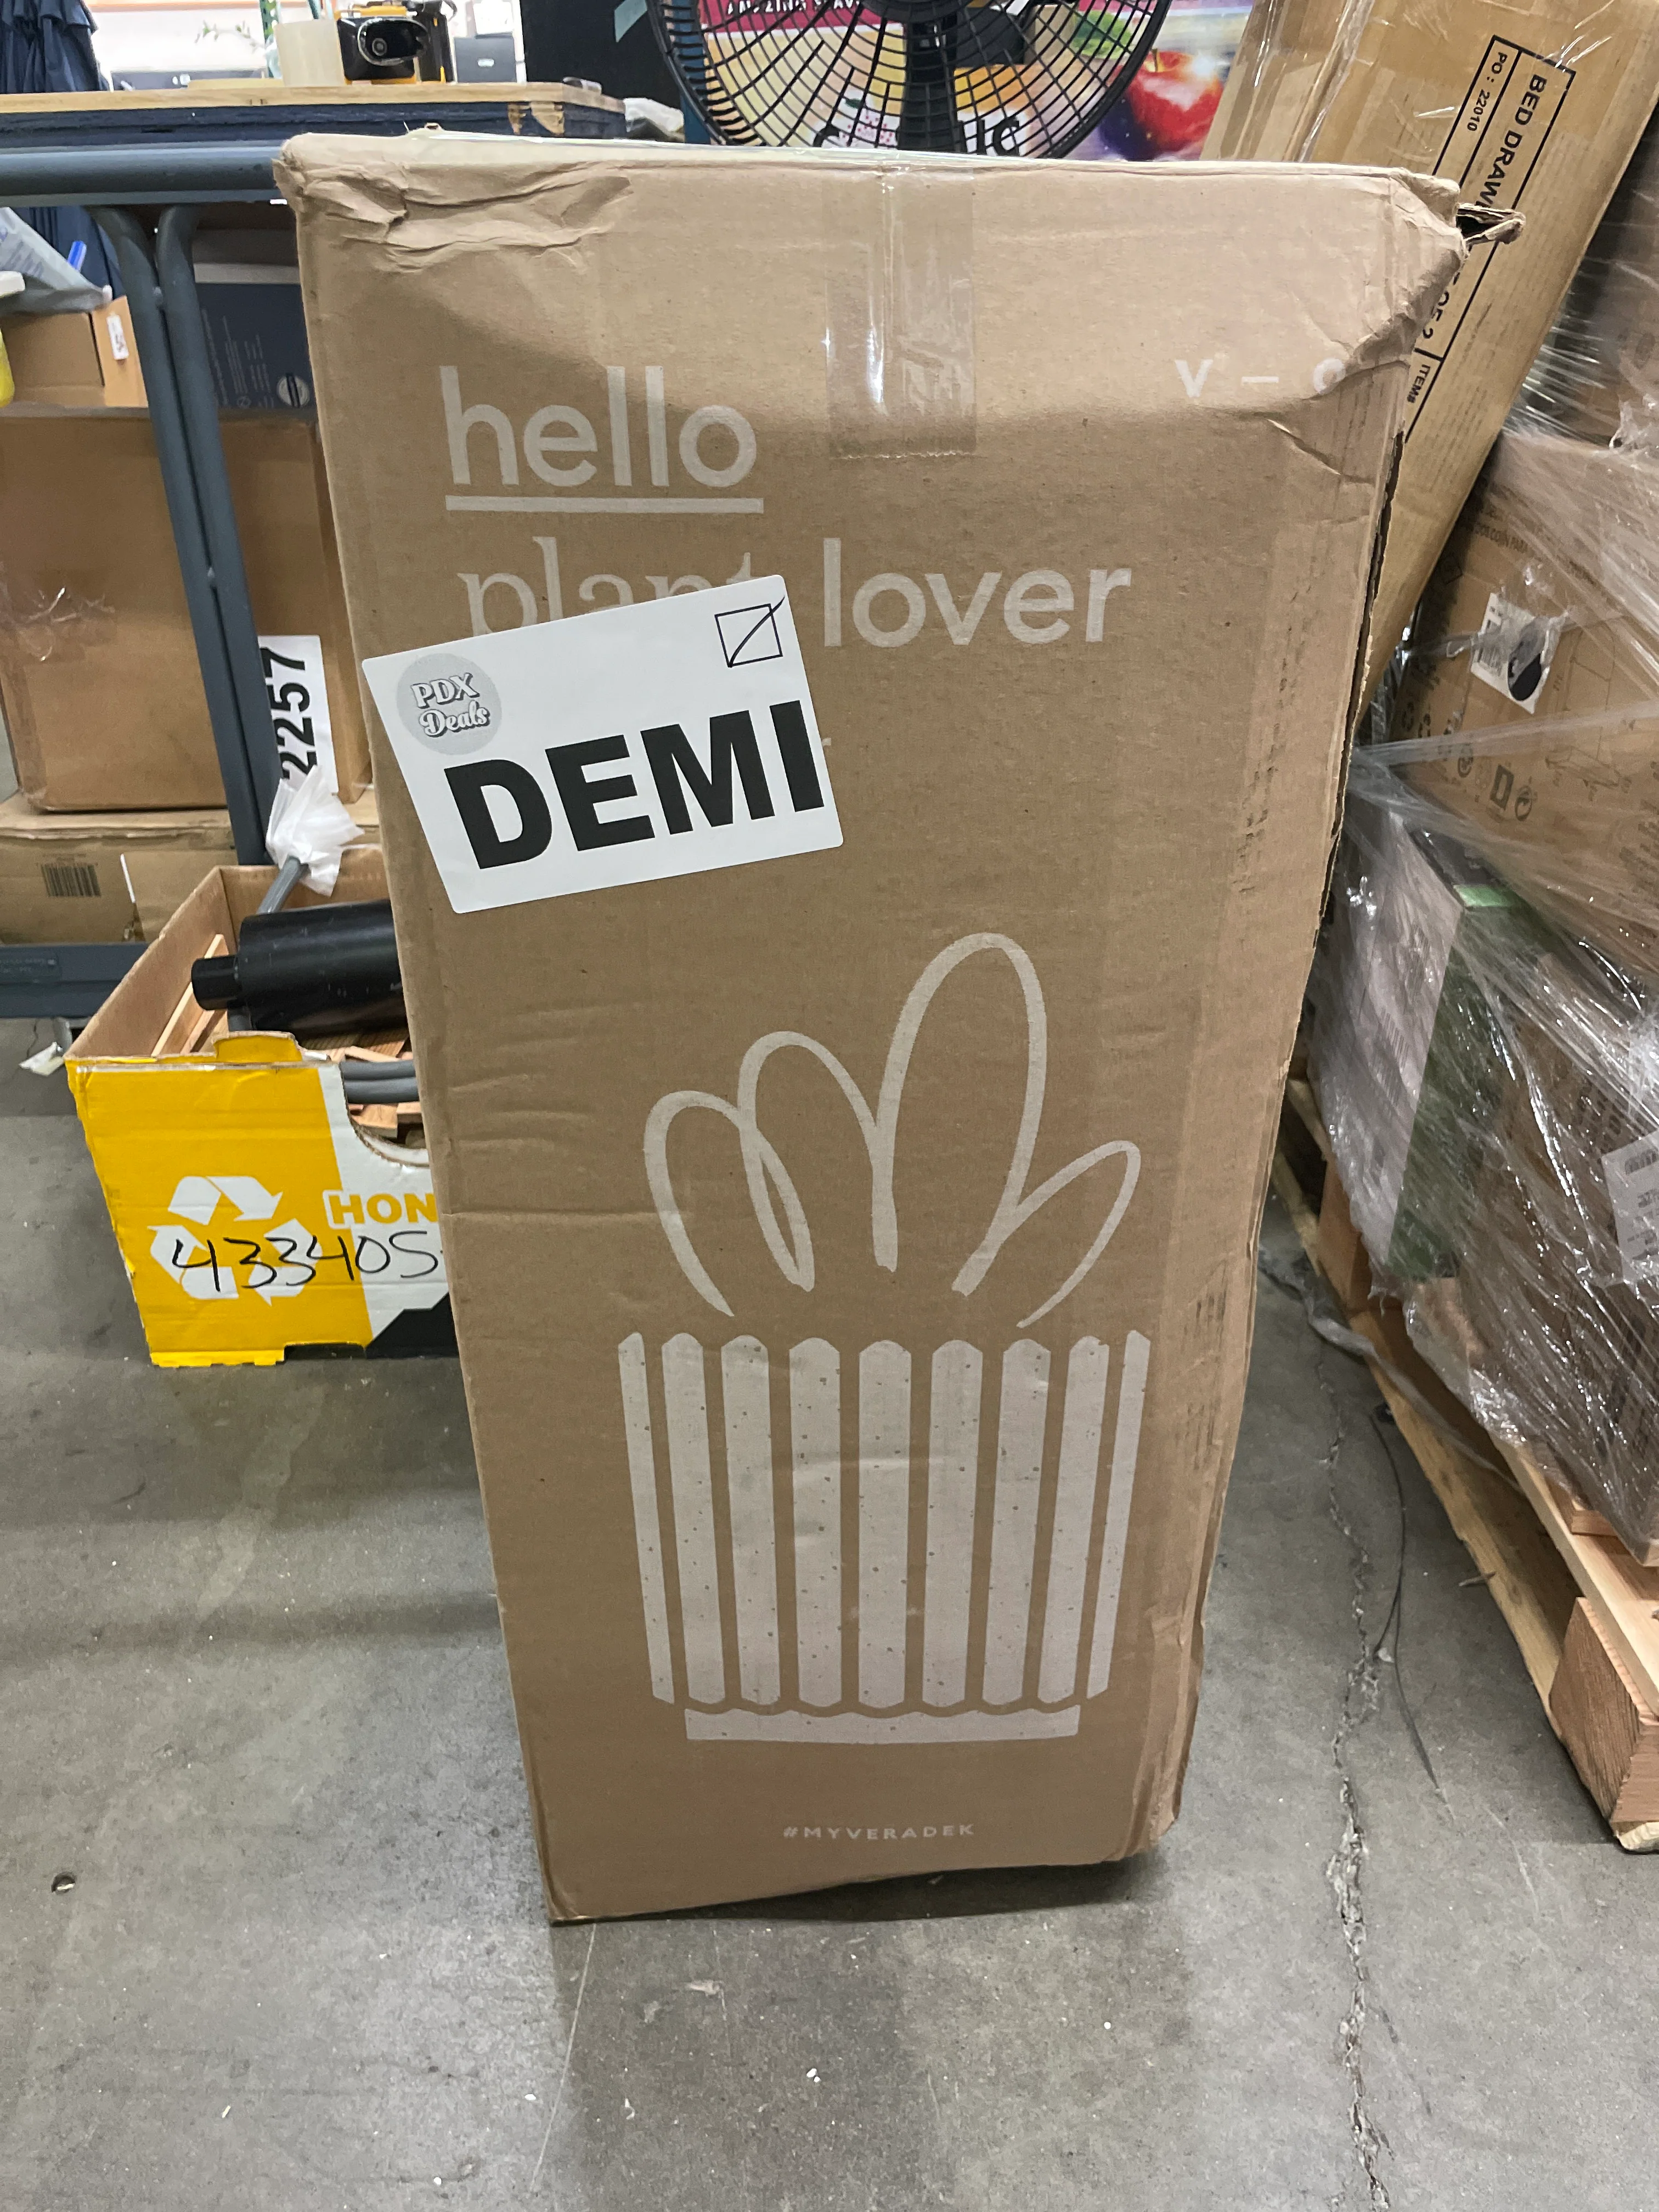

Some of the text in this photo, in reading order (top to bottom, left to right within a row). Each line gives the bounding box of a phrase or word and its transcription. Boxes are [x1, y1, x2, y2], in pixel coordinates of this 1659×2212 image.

[1466, 89, 1490, 132] 22010
[1514, 74, 1548, 126] BED
[439, 365, 757, 487] hello
[823, 538, 1132, 648] lover
[259, 647, 318, 780] 2257
[410, 672, 480, 709] PDX
[419, 699, 491, 737] Deals
[444, 700, 825, 869] DEMI
[783, 1823, 974, 1841] #MYVERADEK
